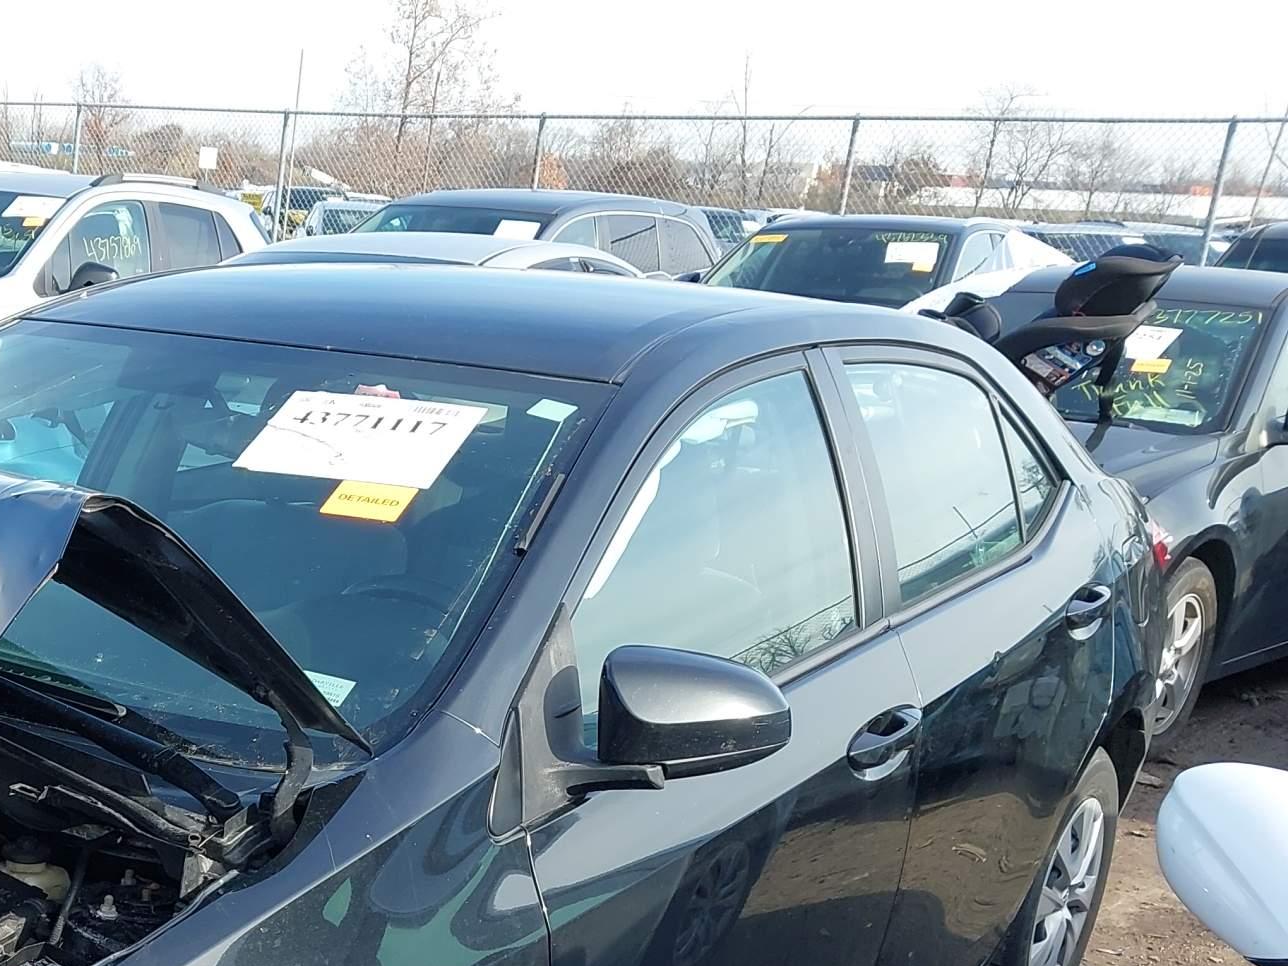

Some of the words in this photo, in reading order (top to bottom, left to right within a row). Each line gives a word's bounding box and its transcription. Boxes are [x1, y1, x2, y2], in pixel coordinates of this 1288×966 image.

[1146, 308, 1264, 325] 3777251
[292, 410, 448, 436] 43771117
[338, 493, 400, 507] DETAILED
